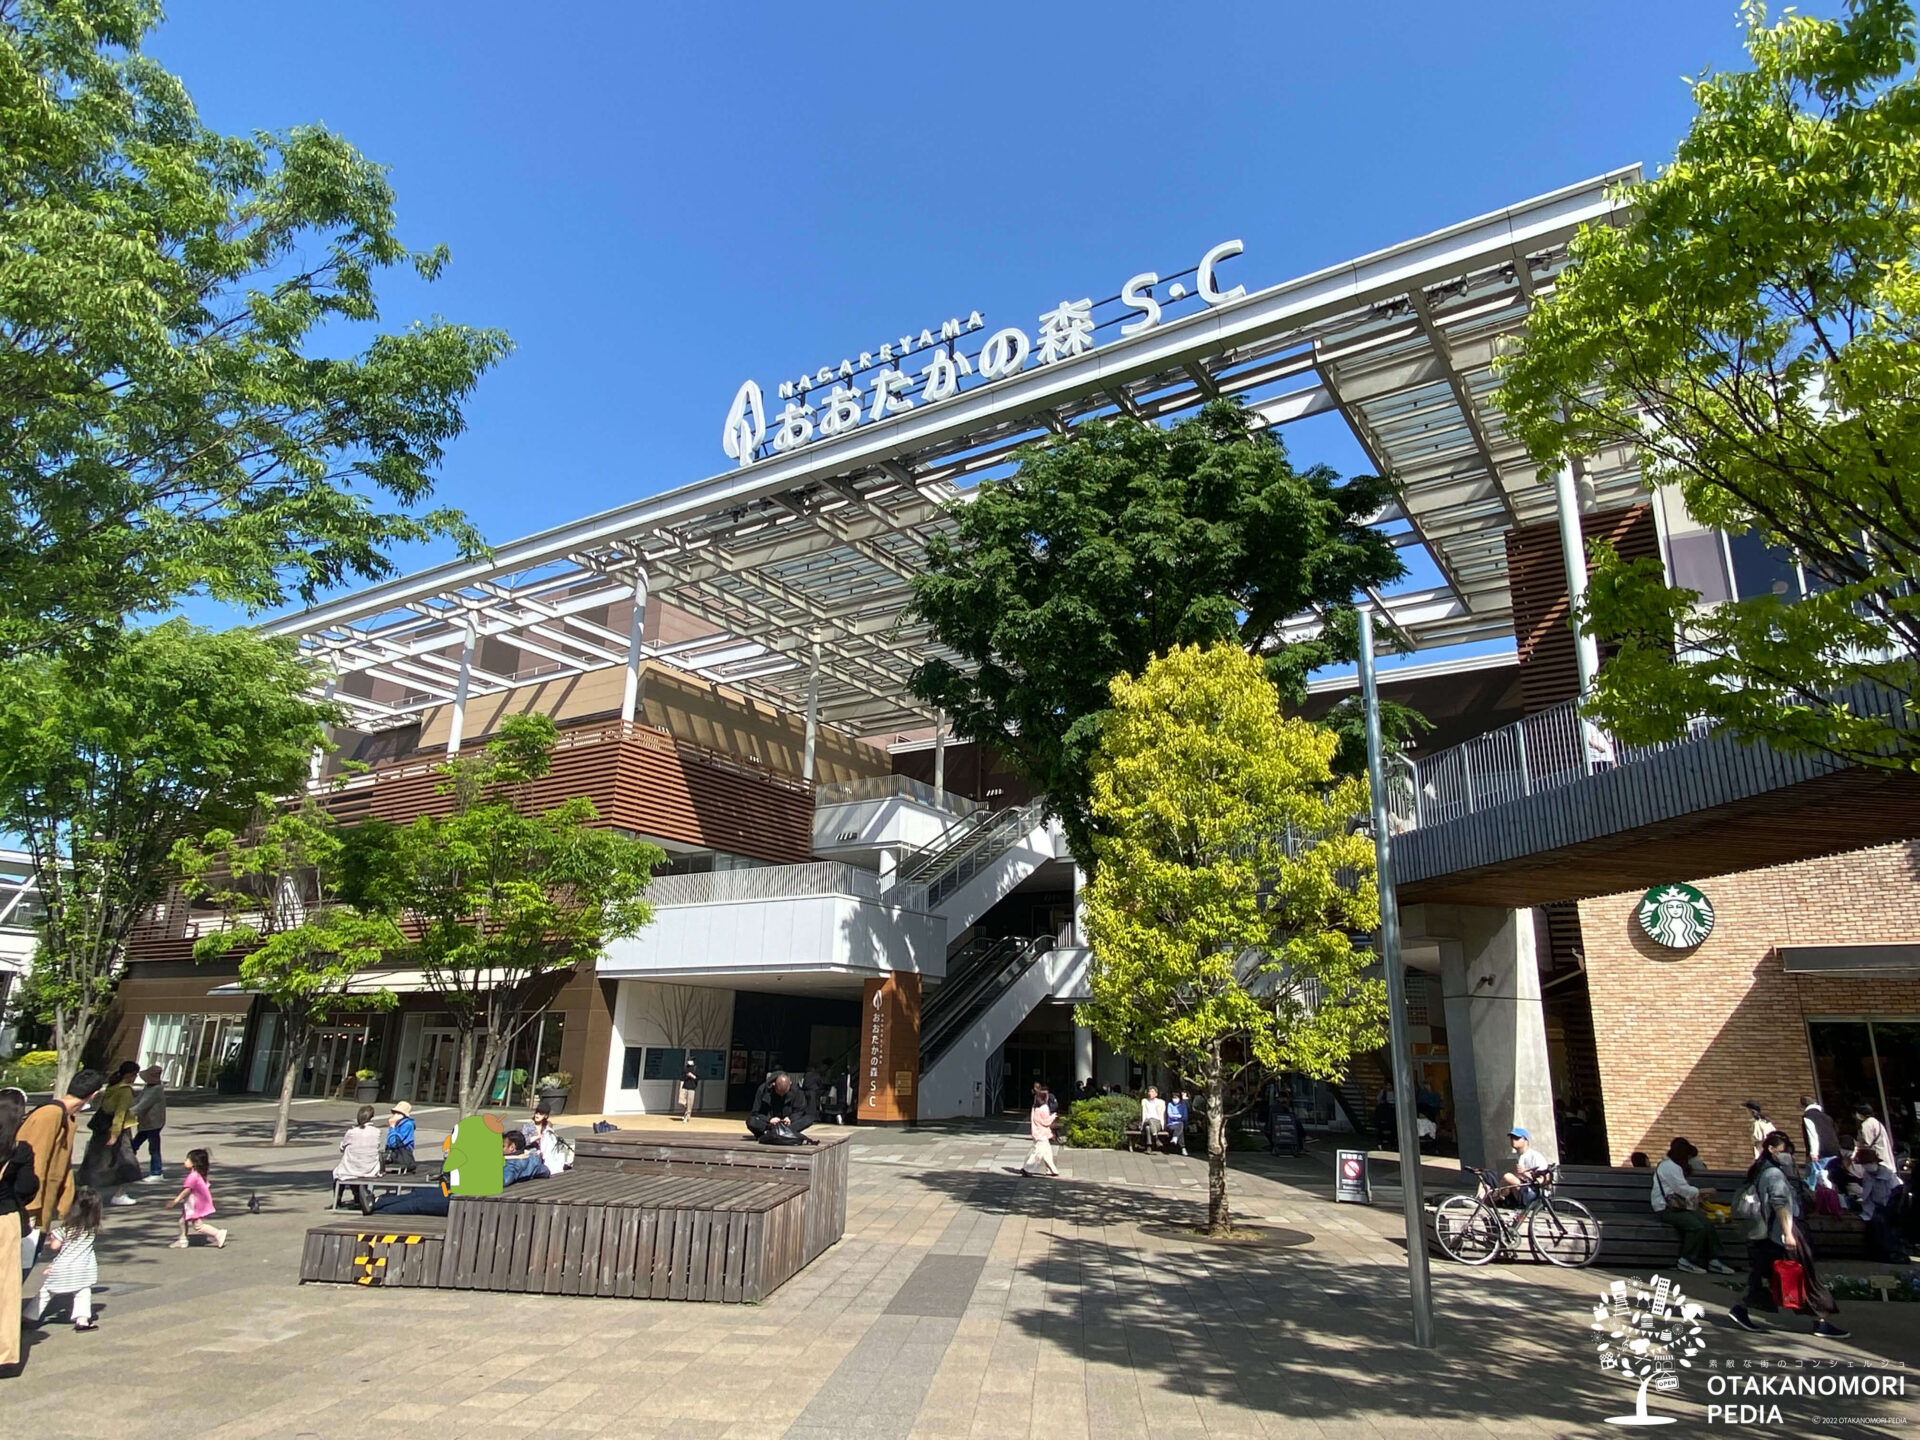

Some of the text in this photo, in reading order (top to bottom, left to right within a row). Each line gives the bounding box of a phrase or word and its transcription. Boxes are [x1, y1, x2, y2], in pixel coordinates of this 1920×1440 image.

[772, 297, 1093, 455] おおたかの森
[779, 311, 984, 398] NAGAREYAMA
